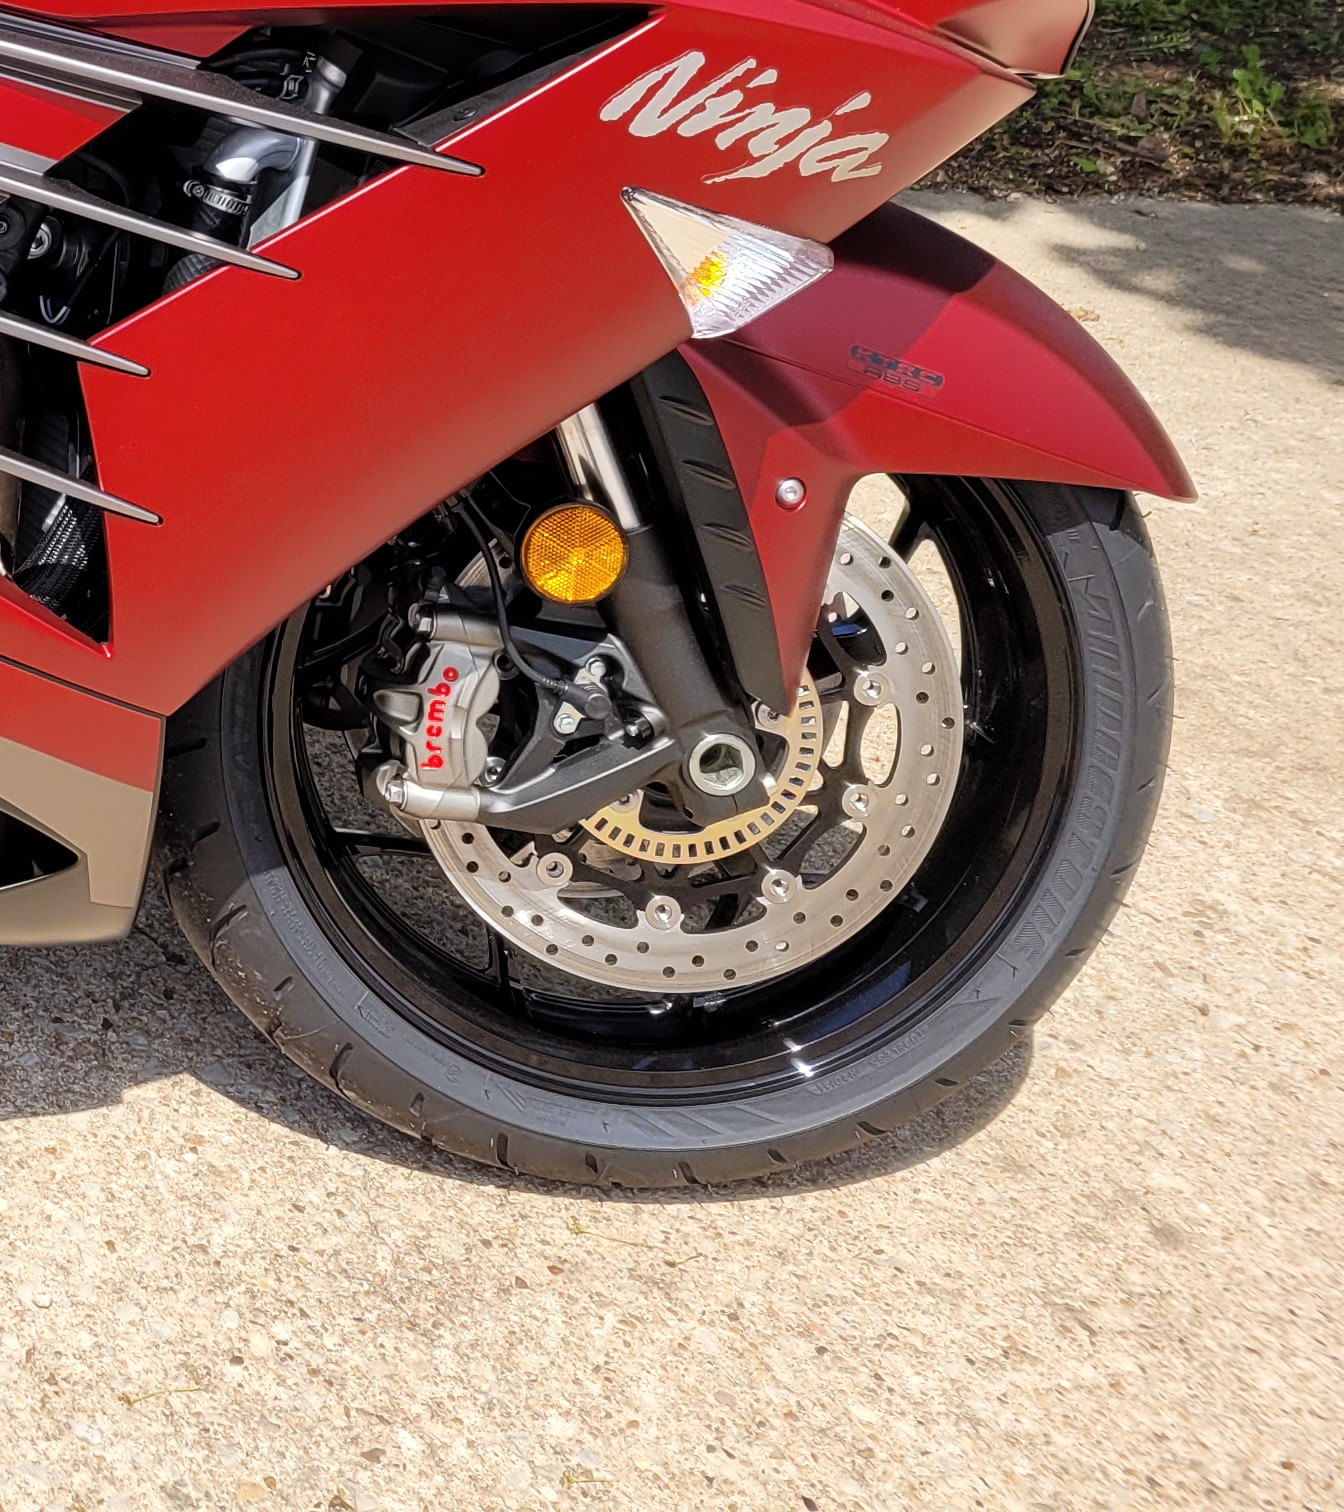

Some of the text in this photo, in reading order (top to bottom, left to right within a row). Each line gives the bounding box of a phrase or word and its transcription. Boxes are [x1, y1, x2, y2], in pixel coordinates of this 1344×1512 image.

[598, 48, 890, 184] Ninja
[864, 366, 921, 391] ABS
[420, 666, 459, 771] brembo
